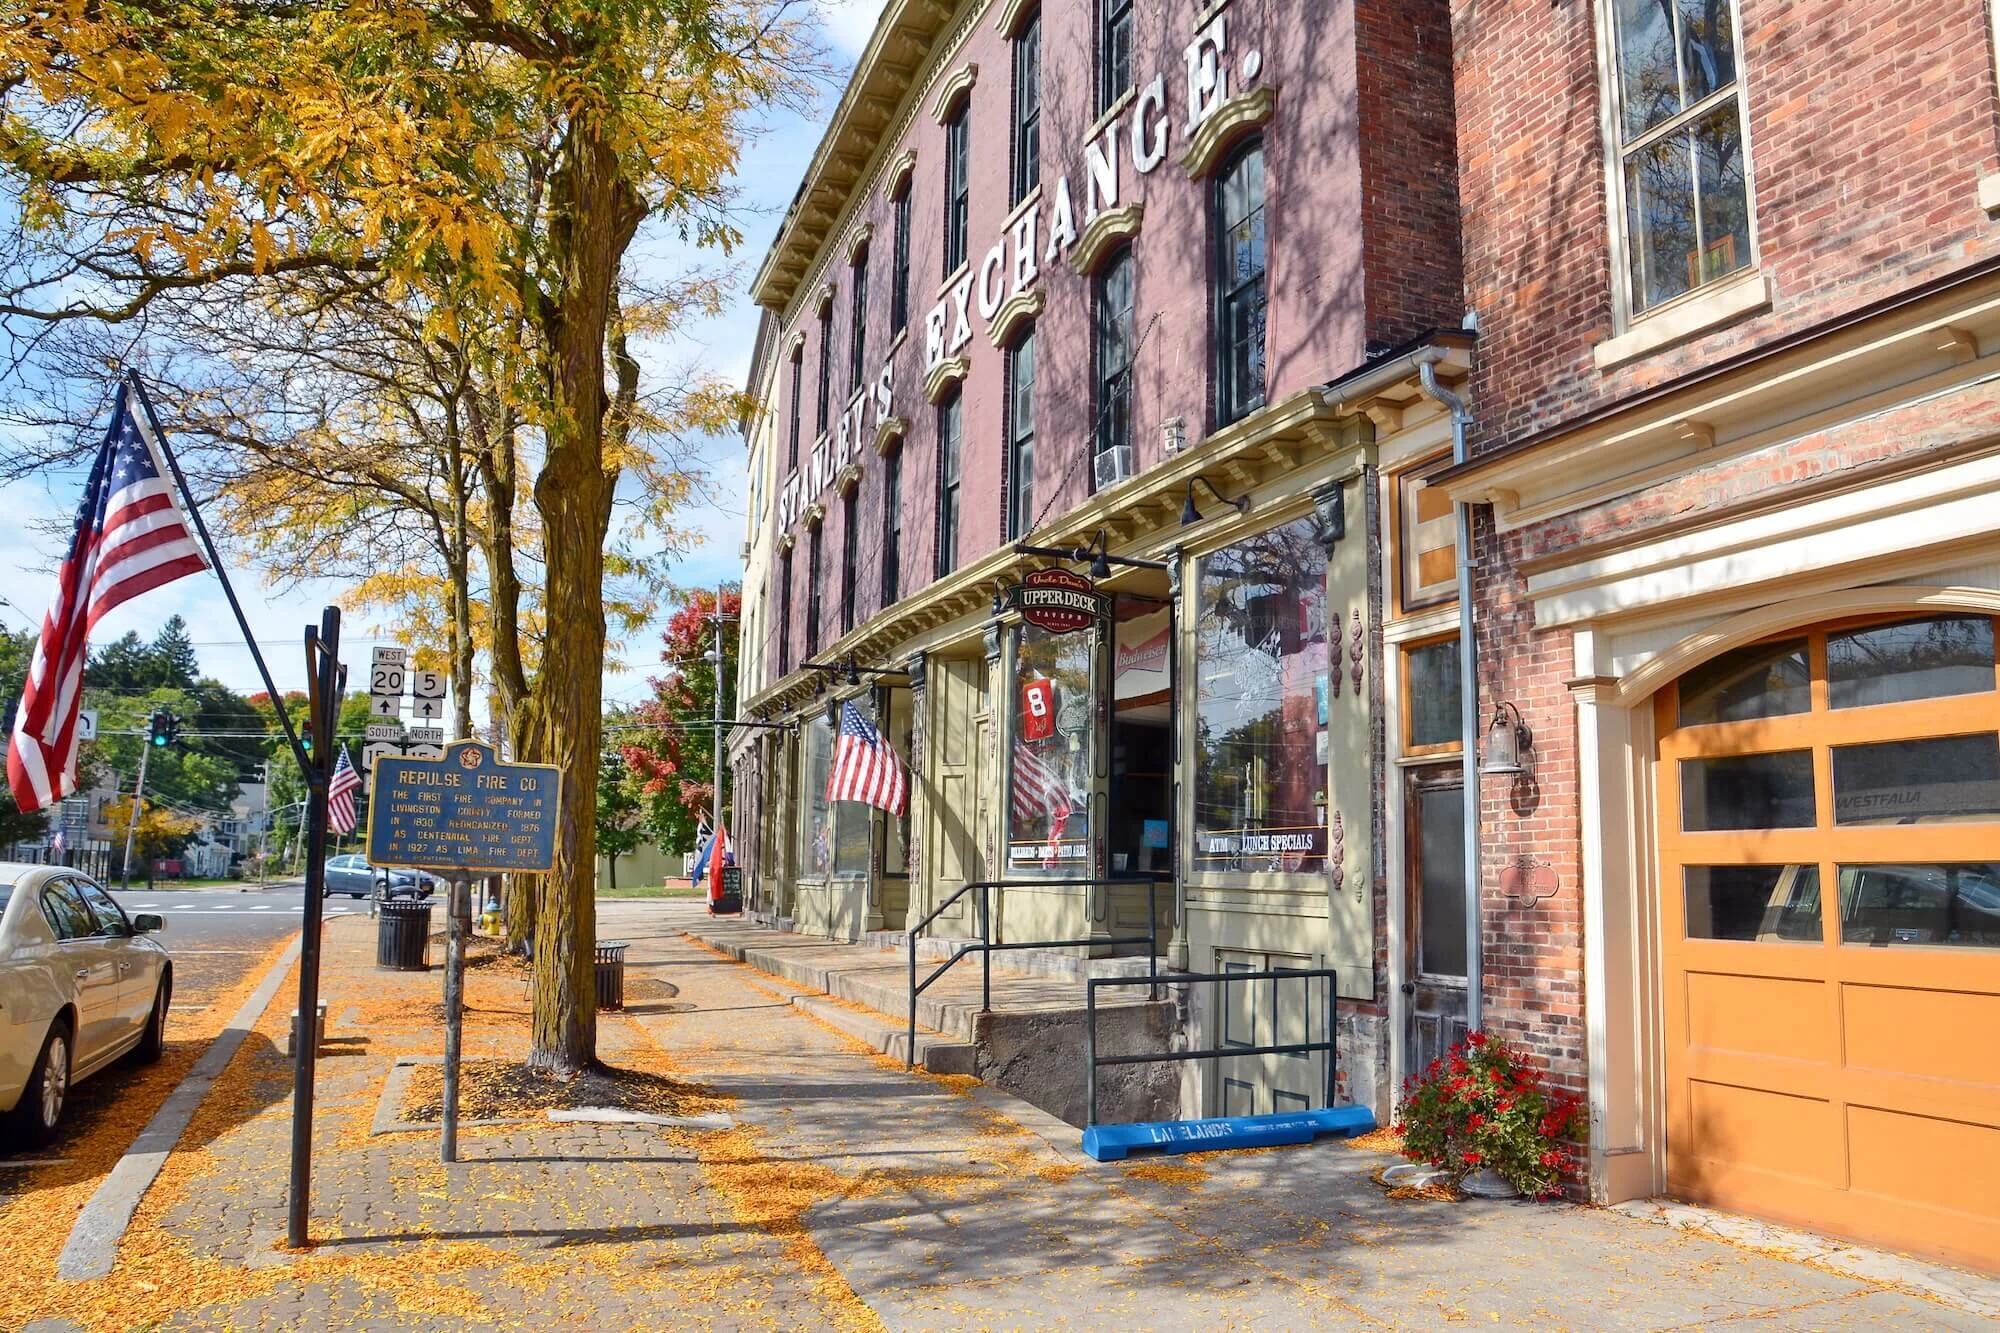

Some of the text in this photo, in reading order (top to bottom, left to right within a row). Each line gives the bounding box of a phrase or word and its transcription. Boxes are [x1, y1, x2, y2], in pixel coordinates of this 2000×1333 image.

[778, 359, 893, 536] STANLEY'S
[1023, 590, 1096, 613] UPPER DECK
[378, 650, 402, 660] WEST
[1119, 644, 1167, 666] Budweiser
[374, 671, 401, 689] 20
[423, 674, 436, 690] 5
[1027, 687, 1046, 717] 8
[369, 726, 399, 737] SOUTH
[411, 729, 442, 740] NORTH
[399, 770, 537, 791] REPULSE FIRE CO
[392, 790, 542, 807] THE FIRST FIRE COMPANY IN
[1837, 791, 1921, 809] WESTFALIA
[391, 804, 441, 814] LIVINGSTON
[506, 809, 542, 820] FORMED
[390, 816, 400, 825] IN
[394, 829, 407, 839] AS
[417, 831, 471, 842] CENTENNIAL
[482, 833, 501, 843] FIRE
[1242, 833, 1313, 851] LUNCH SPECIALS
[389, 842, 399, 851] IN
[407, 843, 428, 853] 1927
[435, 844, 448, 854] AS
[457, 845, 478, 855] LIMA
[488, 846, 507, 856] FIRE
[1208, 837, 1228, 853] ATM
